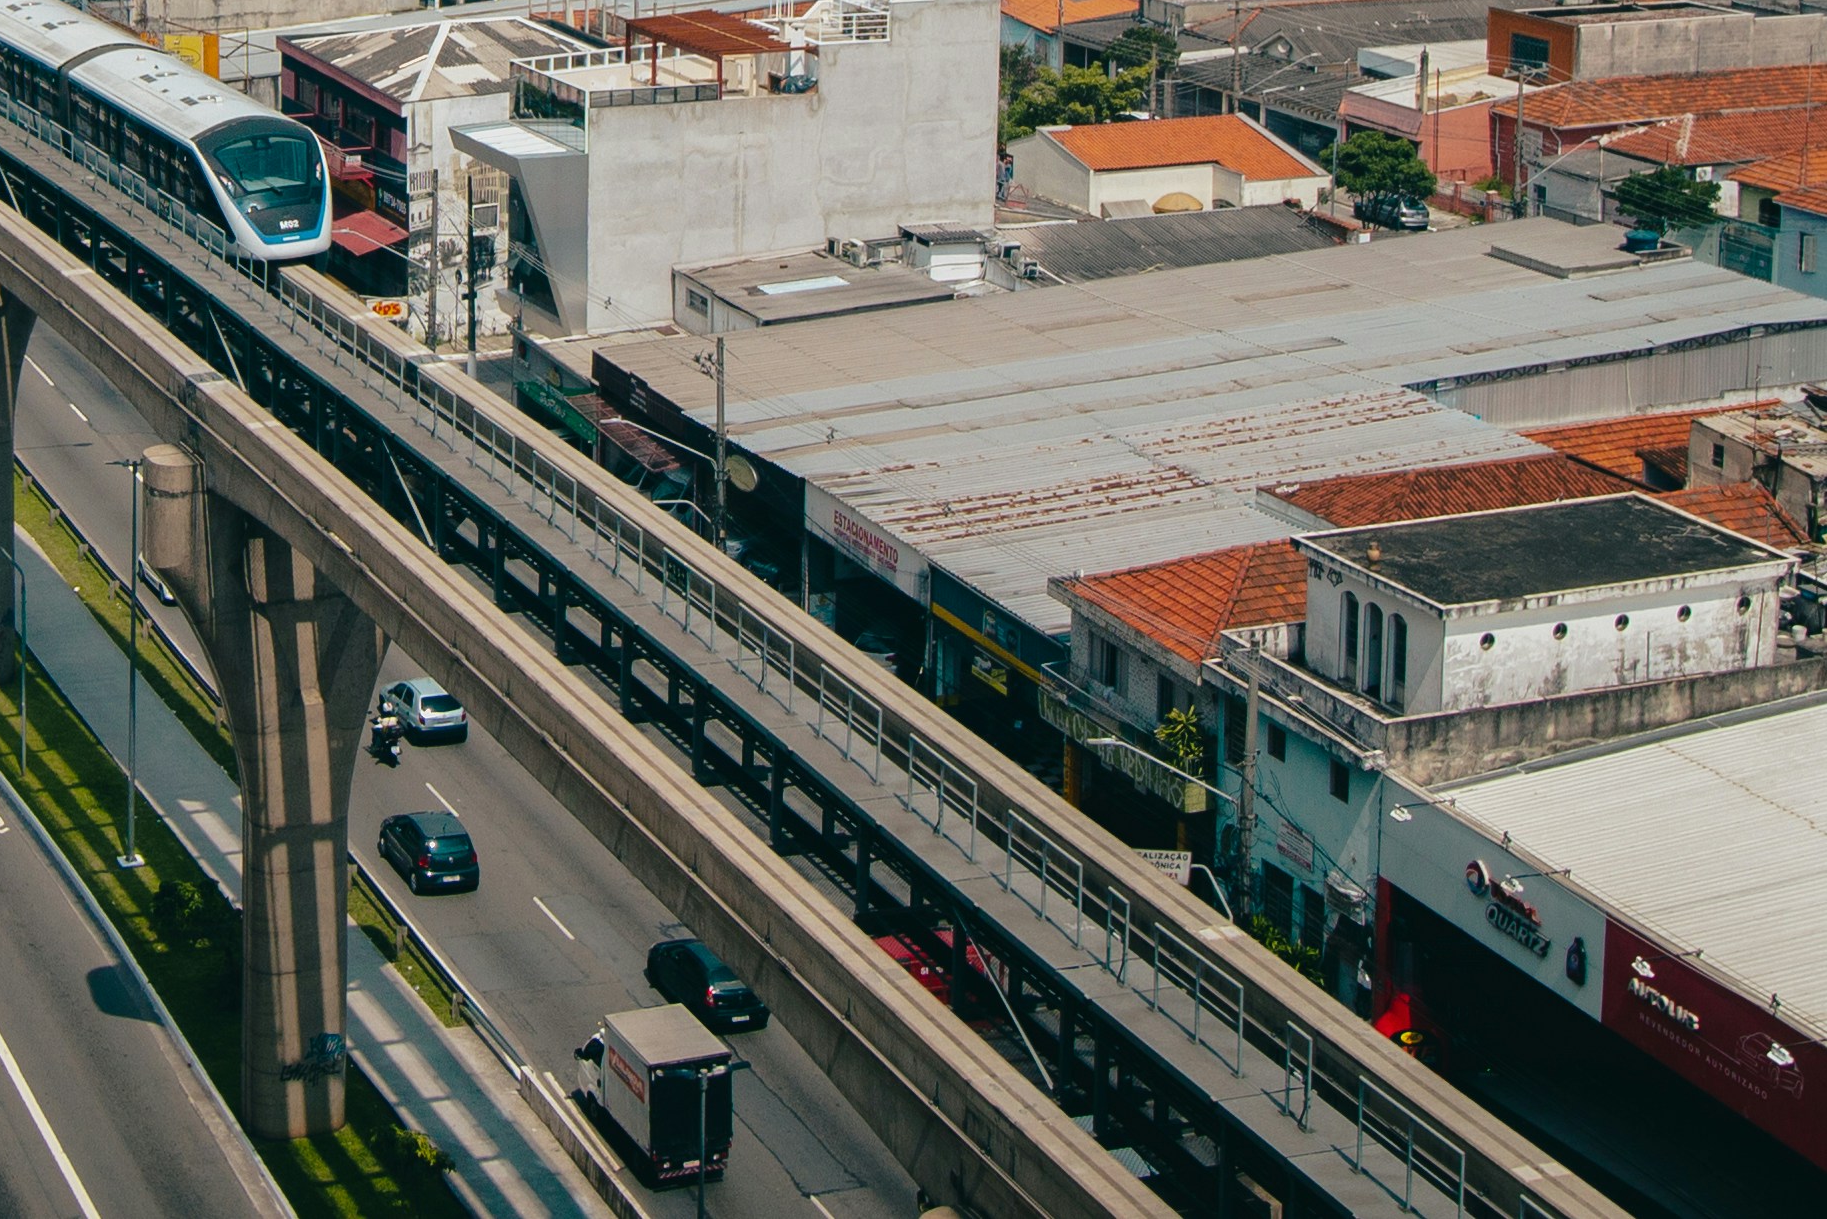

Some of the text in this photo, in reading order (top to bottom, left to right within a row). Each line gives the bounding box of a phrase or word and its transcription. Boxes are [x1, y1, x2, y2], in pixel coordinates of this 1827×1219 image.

[279, 219, 300, 230] M02
[834, 509, 899, 564] ESTACIONAMENTO
[1486, 903, 1550, 957] QUARTZ
[1638, 1011, 1769, 1101] REVENDEDOR AUTORIZADO
